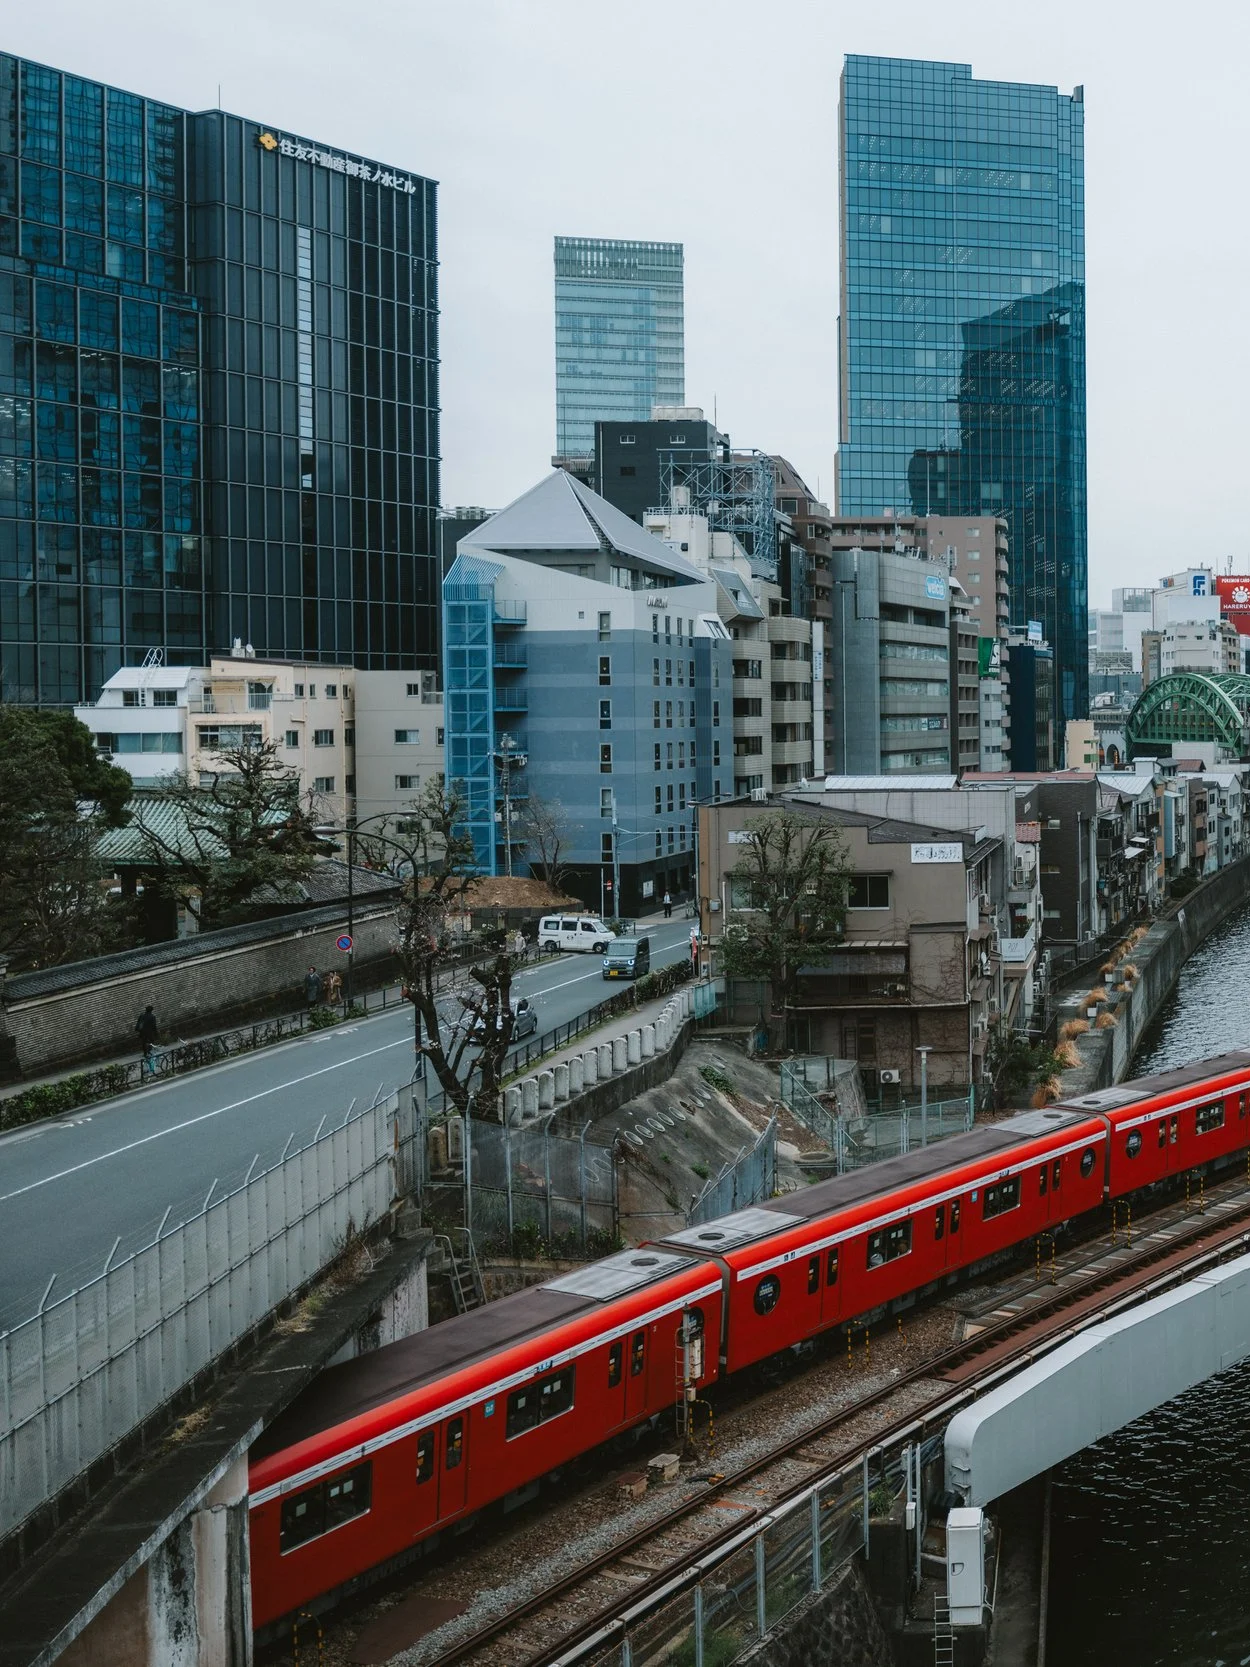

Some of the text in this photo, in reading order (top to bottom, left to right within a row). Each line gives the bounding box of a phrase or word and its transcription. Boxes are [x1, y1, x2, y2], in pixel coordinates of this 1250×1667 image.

[280, 139, 416, 194] 住友不動産御茶ノ水ビル
